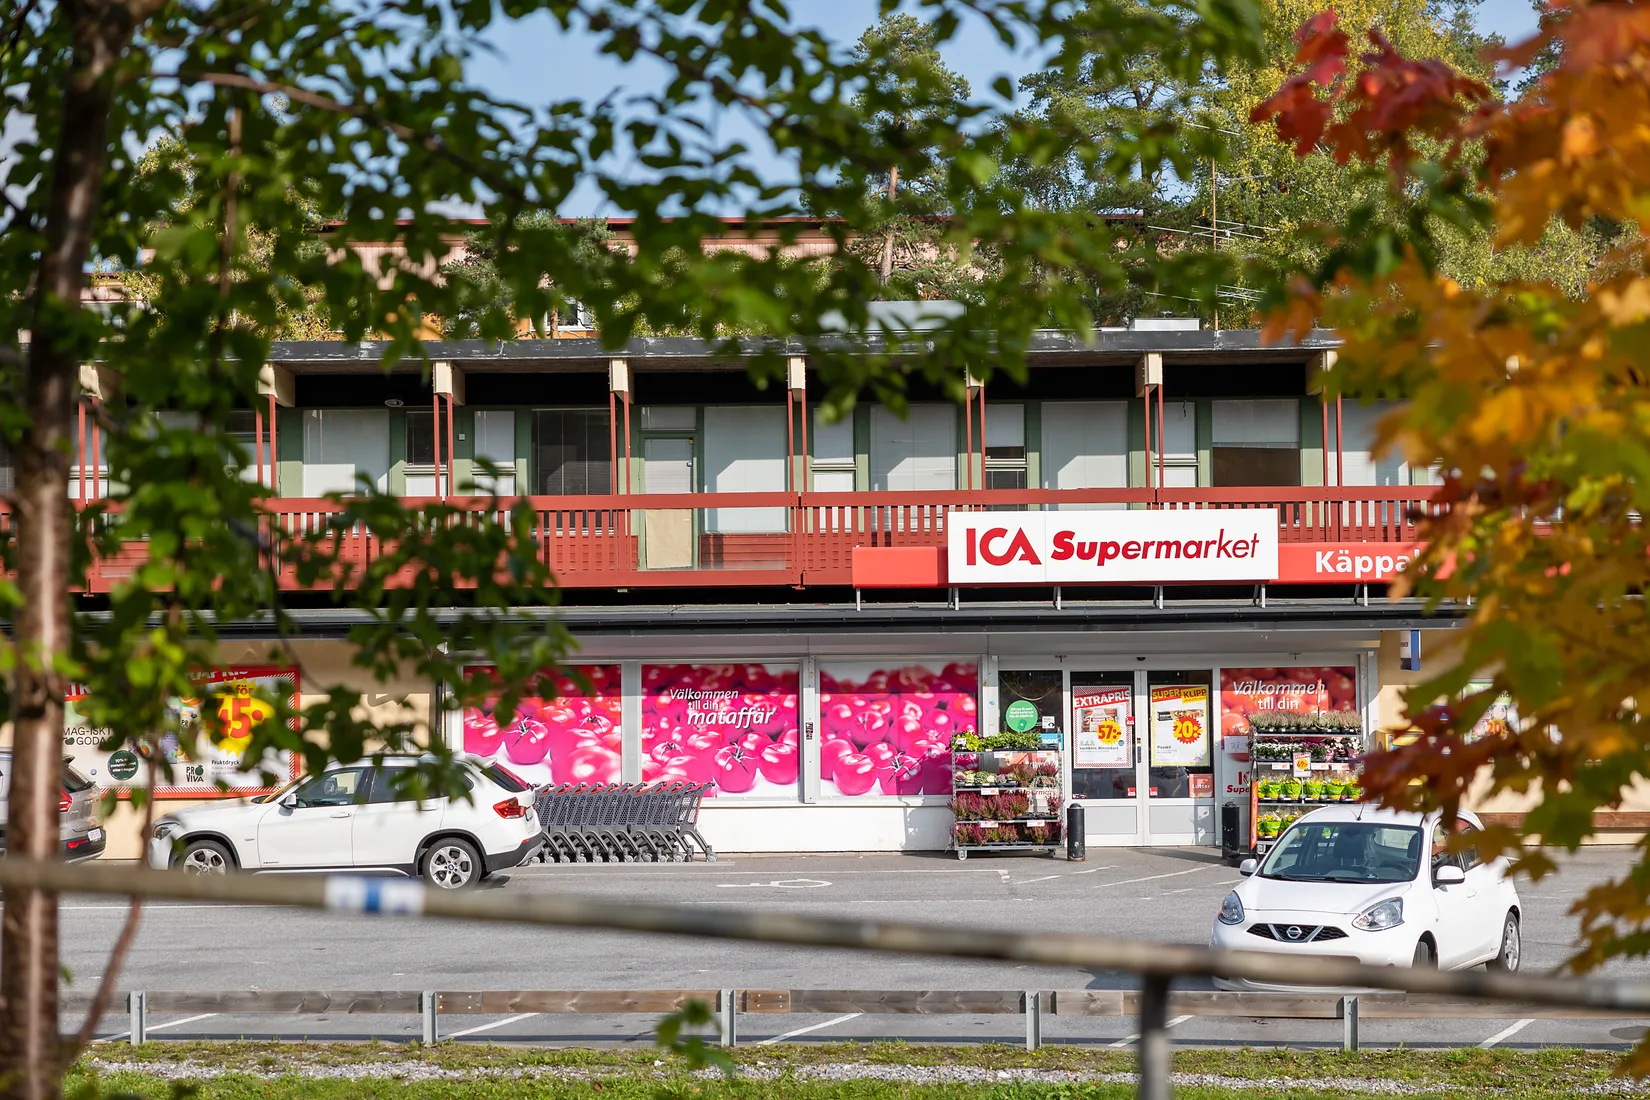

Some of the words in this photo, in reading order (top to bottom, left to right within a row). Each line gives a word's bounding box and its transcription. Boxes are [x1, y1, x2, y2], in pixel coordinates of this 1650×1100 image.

[965, 527, 1042, 566] ICA
[1051, 528, 1259, 567] Supermarket
[1315, 548, 1429, 579] Käppa
[670, 688, 739, 700] Välkommen
[1152, 689, 1180, 700] SUPER
[1183, 689, 1207, 699] KLIPP
[1232, 680, 1326, 696] Välkommen
[688, 700, 700, 710] till
[702, 700, 719, 710] din
[1074, 690, 1130, 707] EXTRAPRIS
[1257, 698, 1274, 710] till
[1277, 697, 1299, 710] din
[687, 707, 775, 729] mataffär
[211, 759, 240, 767] Fruktdryck
[186, 773, 204, 783] VIVA
